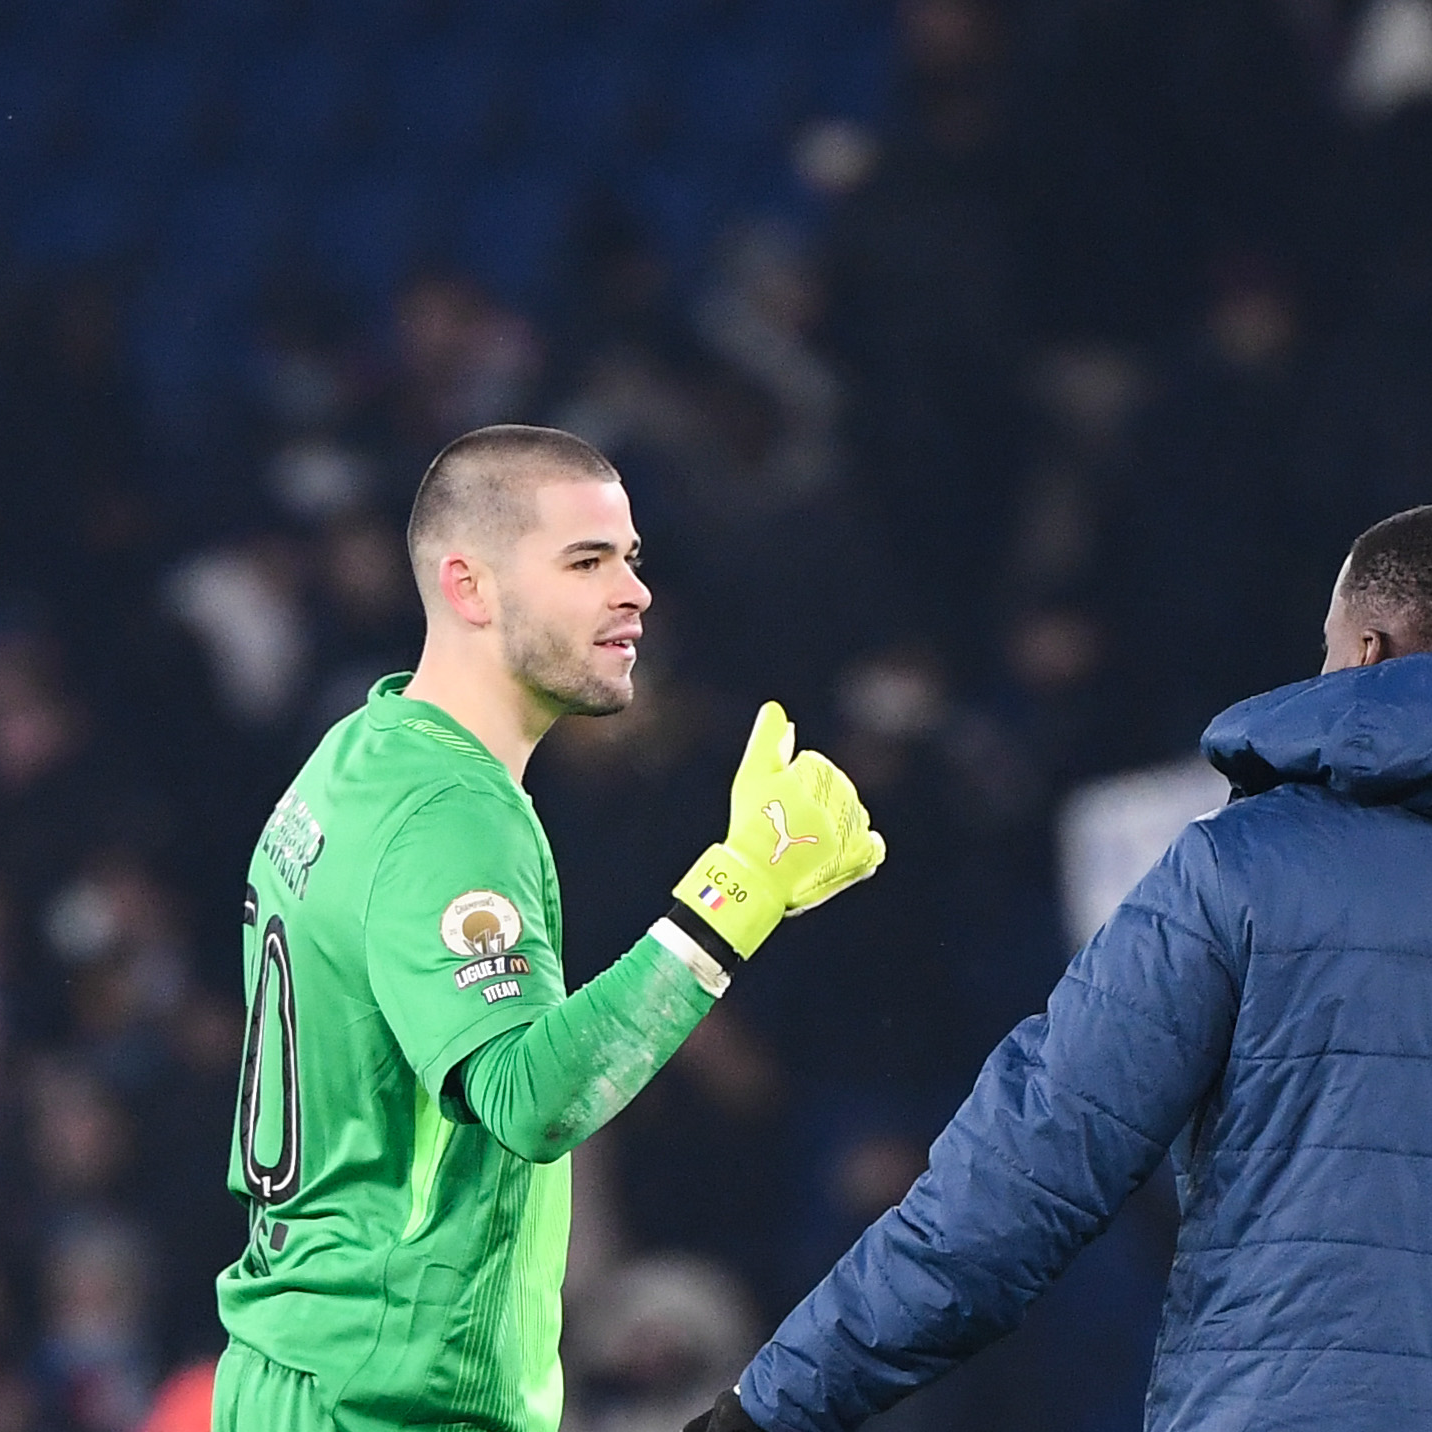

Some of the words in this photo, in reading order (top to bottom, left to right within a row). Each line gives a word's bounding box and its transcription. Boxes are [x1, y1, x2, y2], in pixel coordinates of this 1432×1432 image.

[706, 865, 727, 885] LC
[727, 883, 747, 902] 30
[240, 882, 302, 1205] 0
